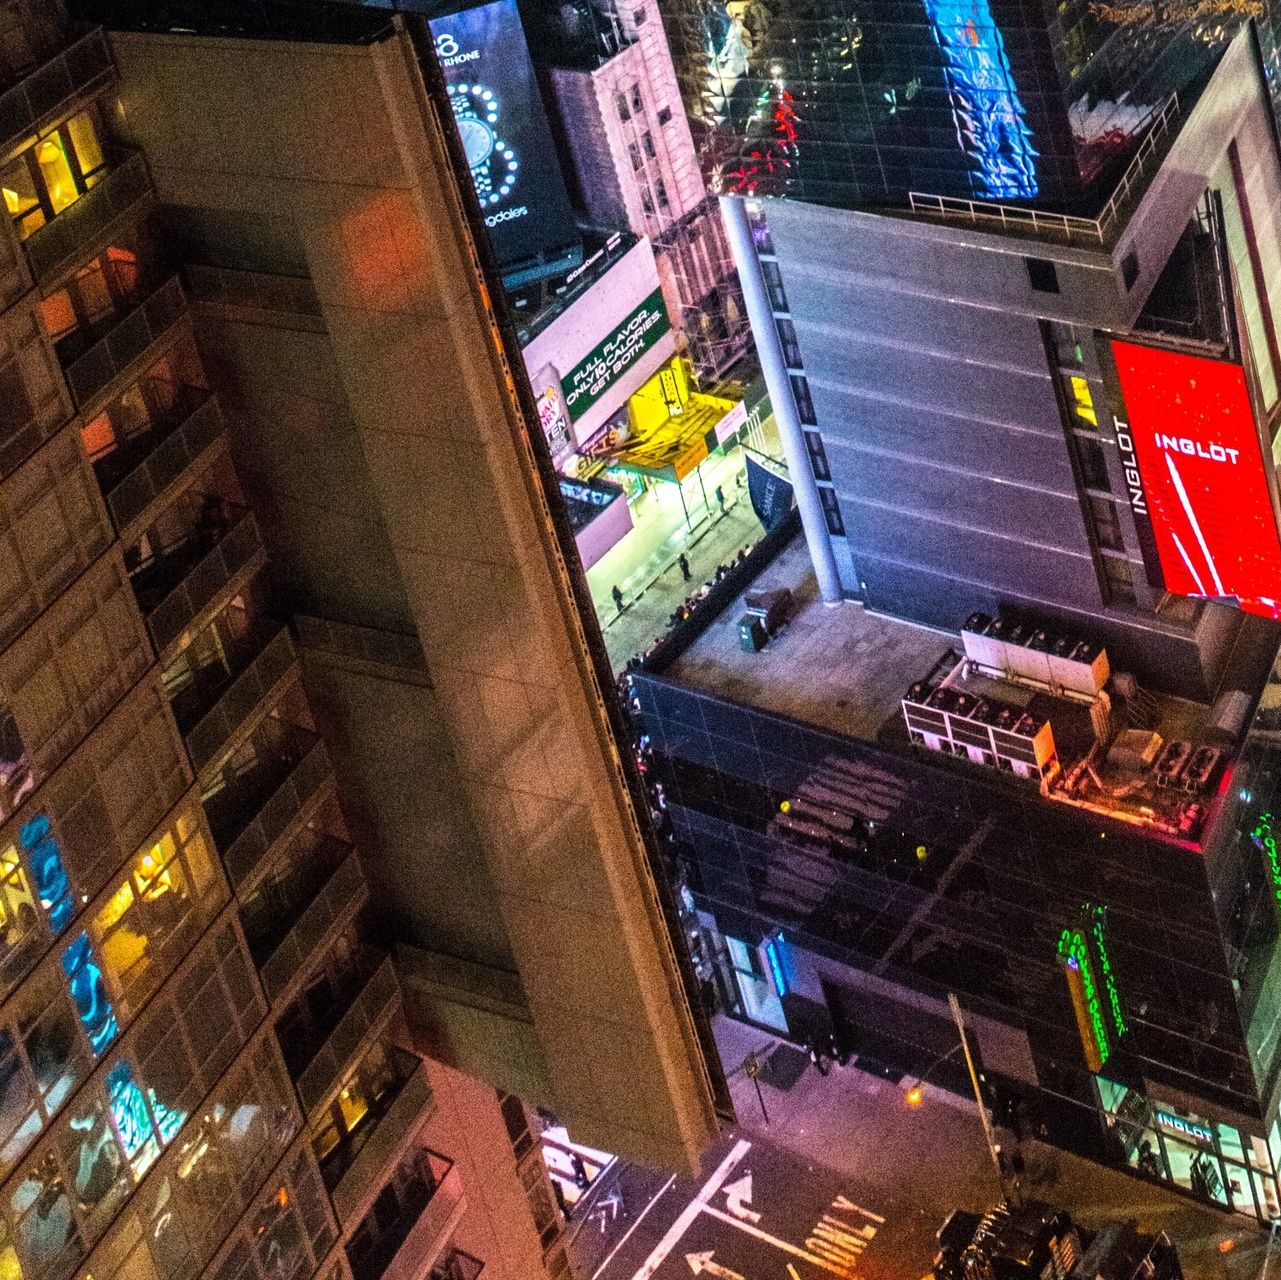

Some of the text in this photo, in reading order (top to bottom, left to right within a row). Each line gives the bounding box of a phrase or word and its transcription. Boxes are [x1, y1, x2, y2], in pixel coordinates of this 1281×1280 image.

[444, 50, 480, 67] RHONE
[573, 309, 650, 386] FULL FLAVOR.
[566, 373, 595, 406] ONLY
[594, 363, 608, 379] 10
[590, 371, 615, 397] GET
[1113, 415, 1148, 515] INGLOT
[1155, 432, 1239, 464] INGLOT
[1157, 1110, 1214, 1143] INGLOT
[804, 1195, 886, 1269] ONLY
